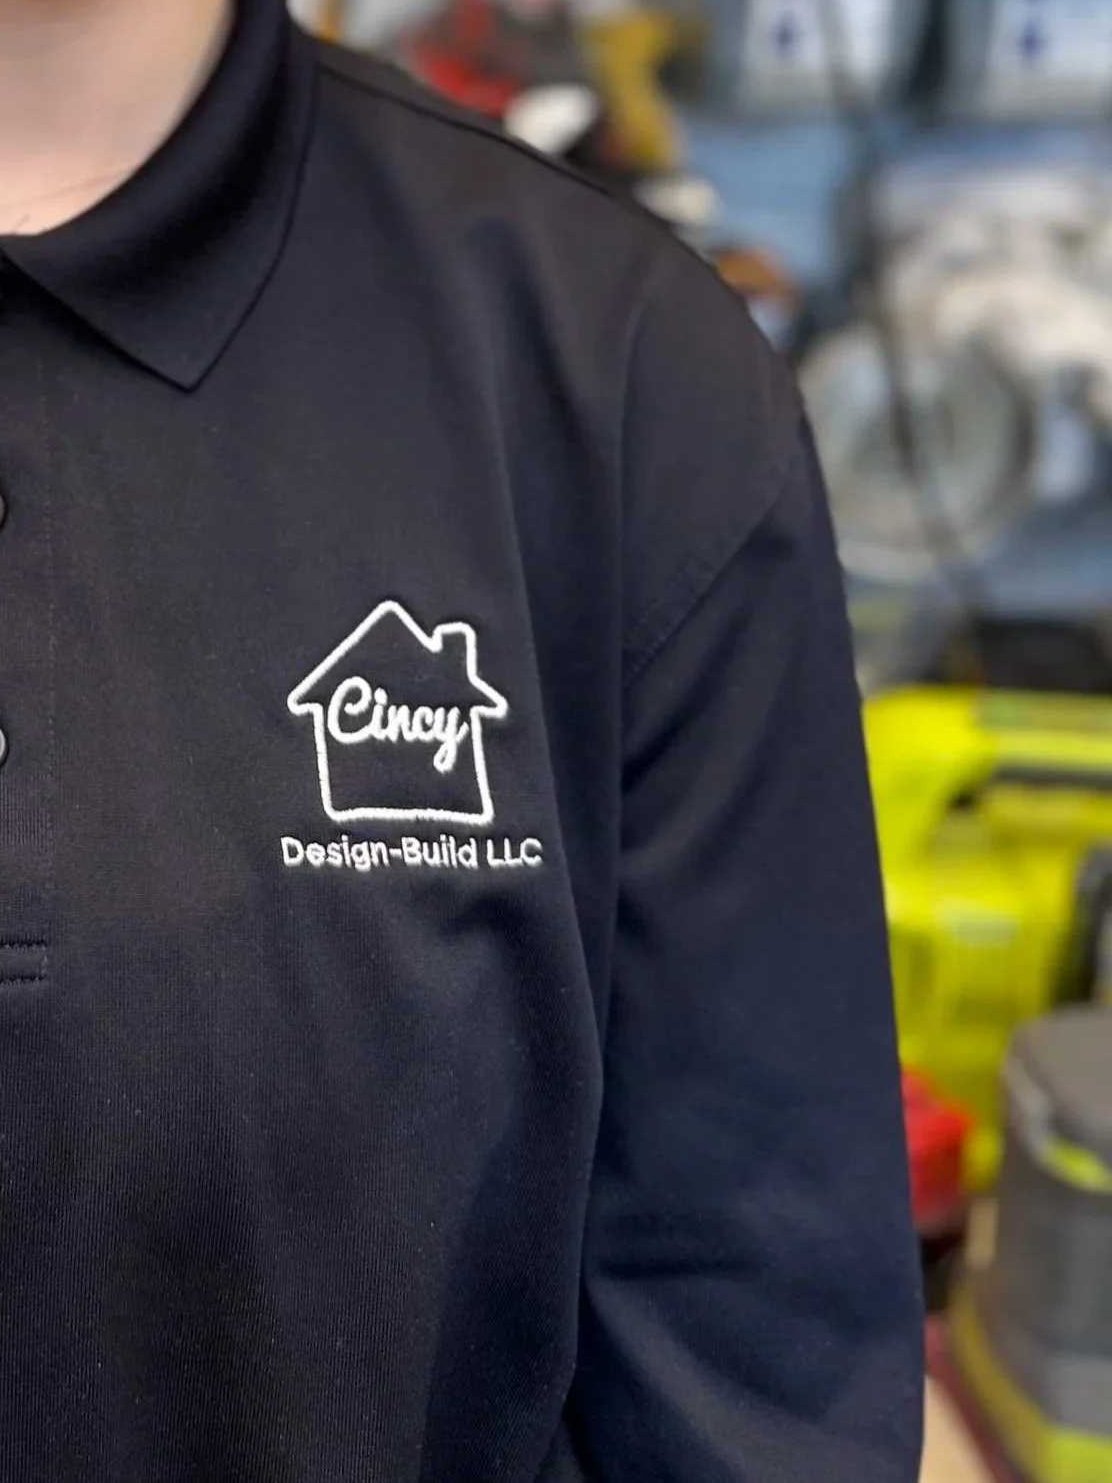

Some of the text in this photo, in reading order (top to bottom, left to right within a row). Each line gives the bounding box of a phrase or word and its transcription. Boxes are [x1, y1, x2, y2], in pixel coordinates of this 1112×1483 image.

[328, 676, 469, 772] Cincy
[280, 834, 542, 872] Design-Build LLC
